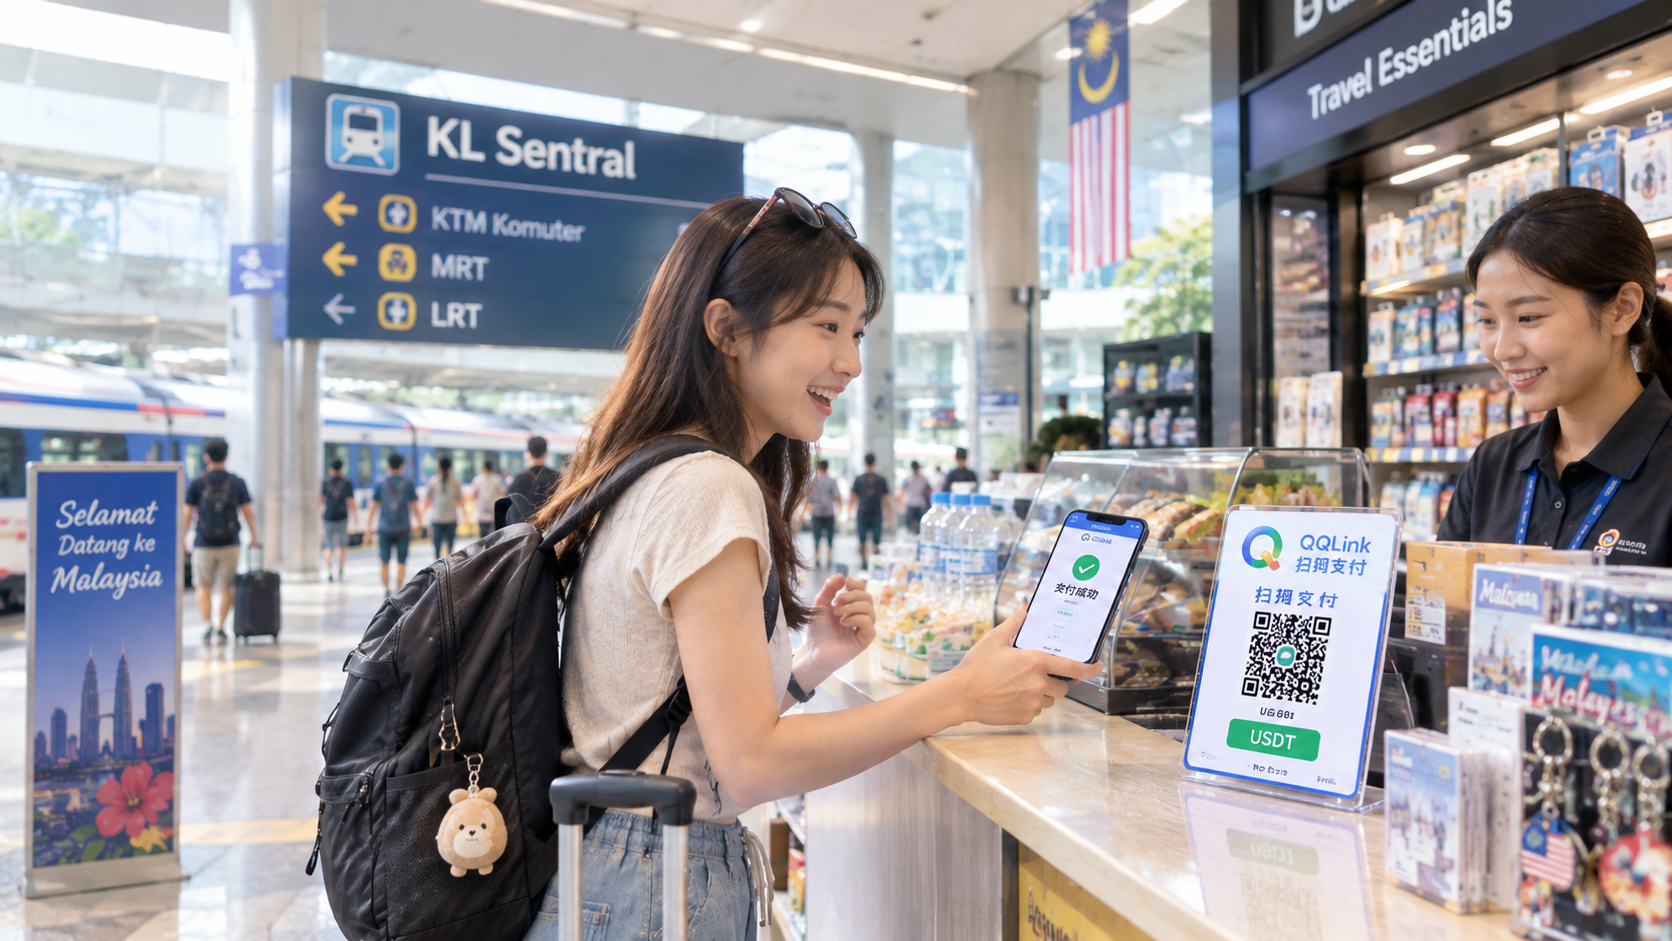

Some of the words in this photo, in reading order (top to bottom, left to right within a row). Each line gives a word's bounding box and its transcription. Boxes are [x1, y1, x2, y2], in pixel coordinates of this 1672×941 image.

[1307, 57, 1373, 119] Travel
[1378, 0, 1513, 87] Essentials
[427, 116, 485, 162] KL
[495, 125, 636, 180] Sentral
[431, 205, 487, 234] KTM
[492, 212, 585, 243] Komuter
[431, 253, 489, 281] MRT
[431, 301, 483, 328] LRT
[56, 499, 158, 529] Selamat
[58, 534, 130, 560] Datang
[134, 533, 156, 553] ke
[1300, 534, 1372, 554] QQLink
[50, 562, 163, 600] Malaysia
[1250, 729, 1297, 750] USDT
